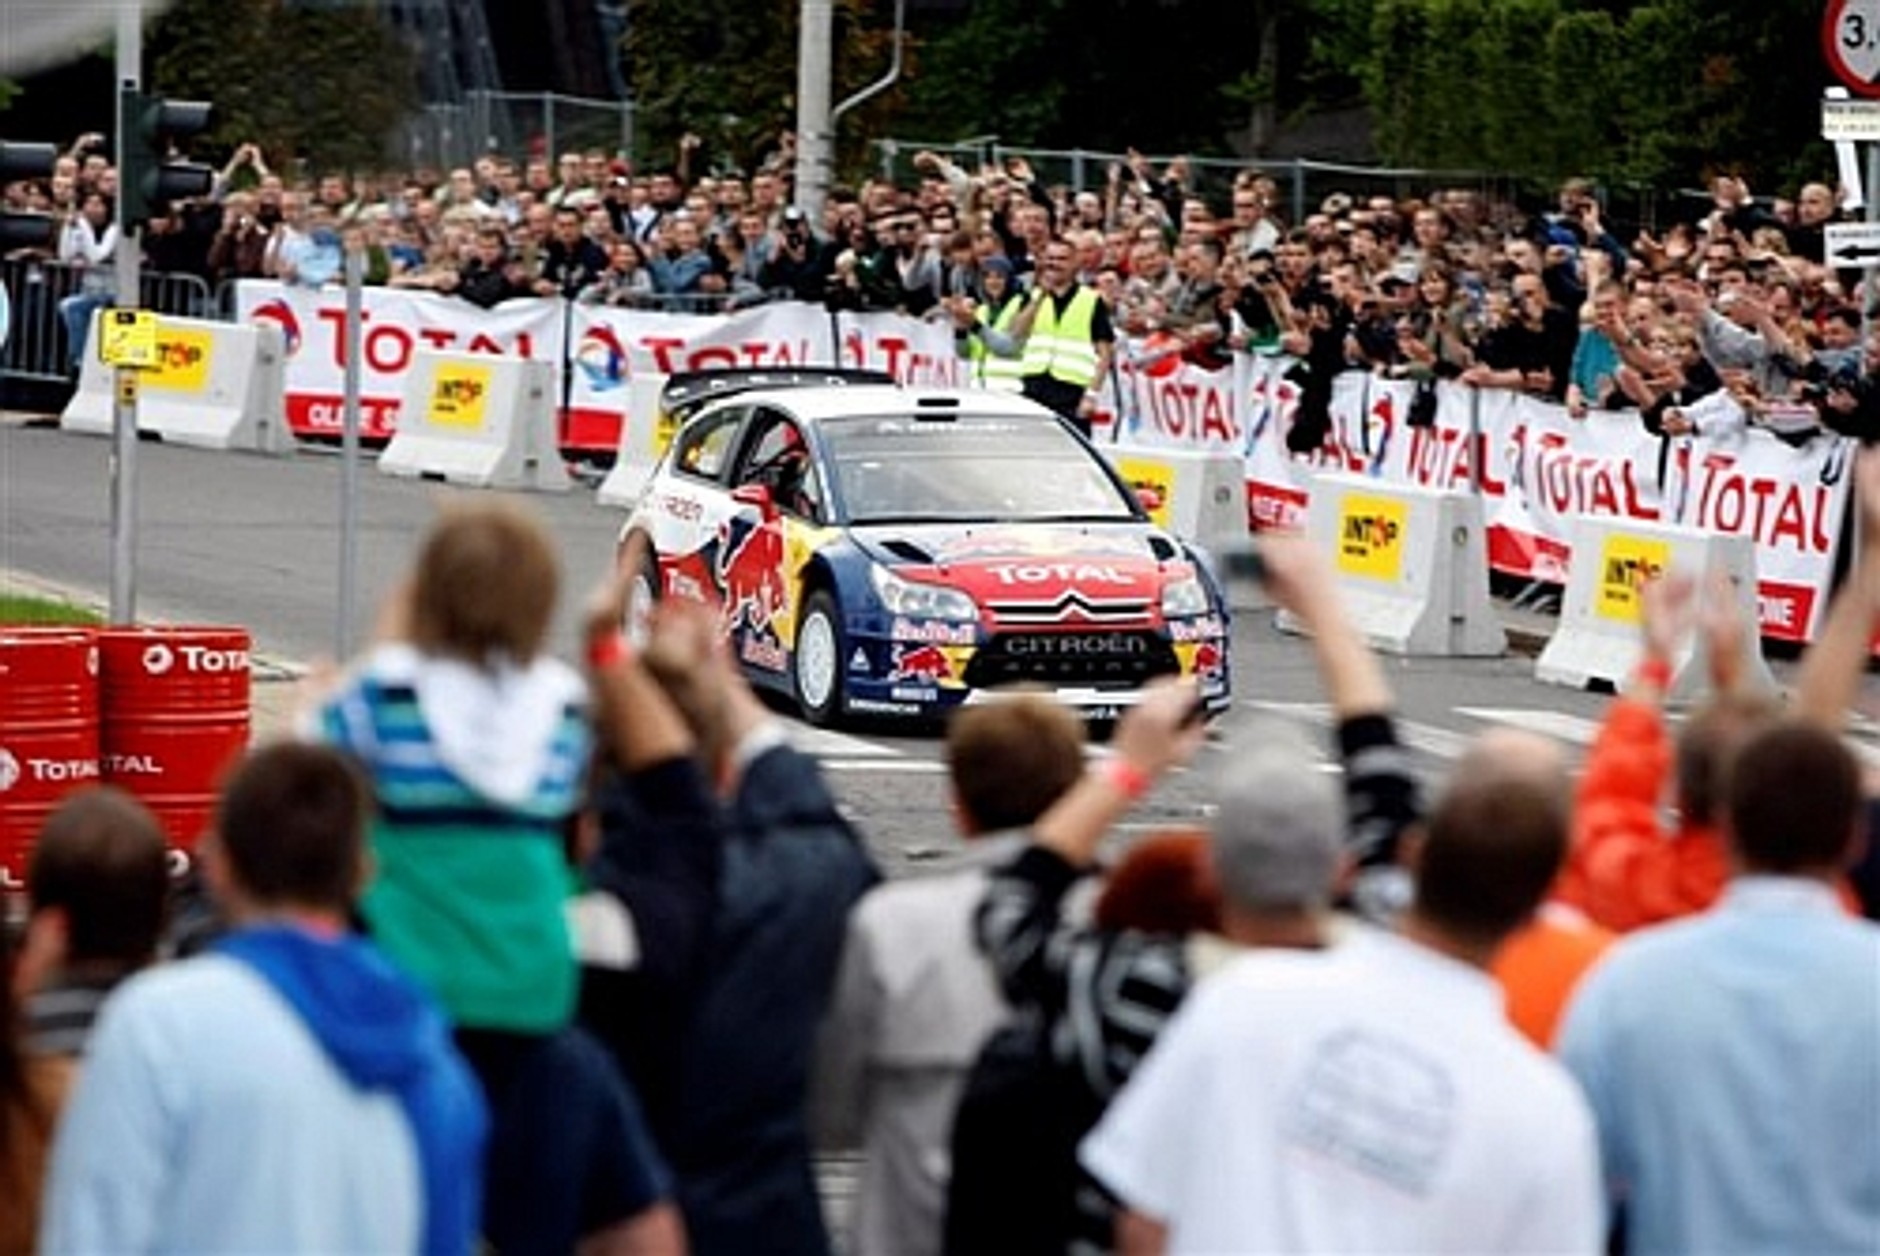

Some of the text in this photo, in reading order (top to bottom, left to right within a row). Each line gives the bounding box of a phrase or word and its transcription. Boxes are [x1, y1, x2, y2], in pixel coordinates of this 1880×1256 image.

[1537, 432, 1660, 521] TOTAL
[1697, 452, 1830, 555] TOTAL
[1342, 514, 1398, 548] INTOP
[984, 563, 1138, 585] TOTAL
[177, 646, 251, 671] TOTA
